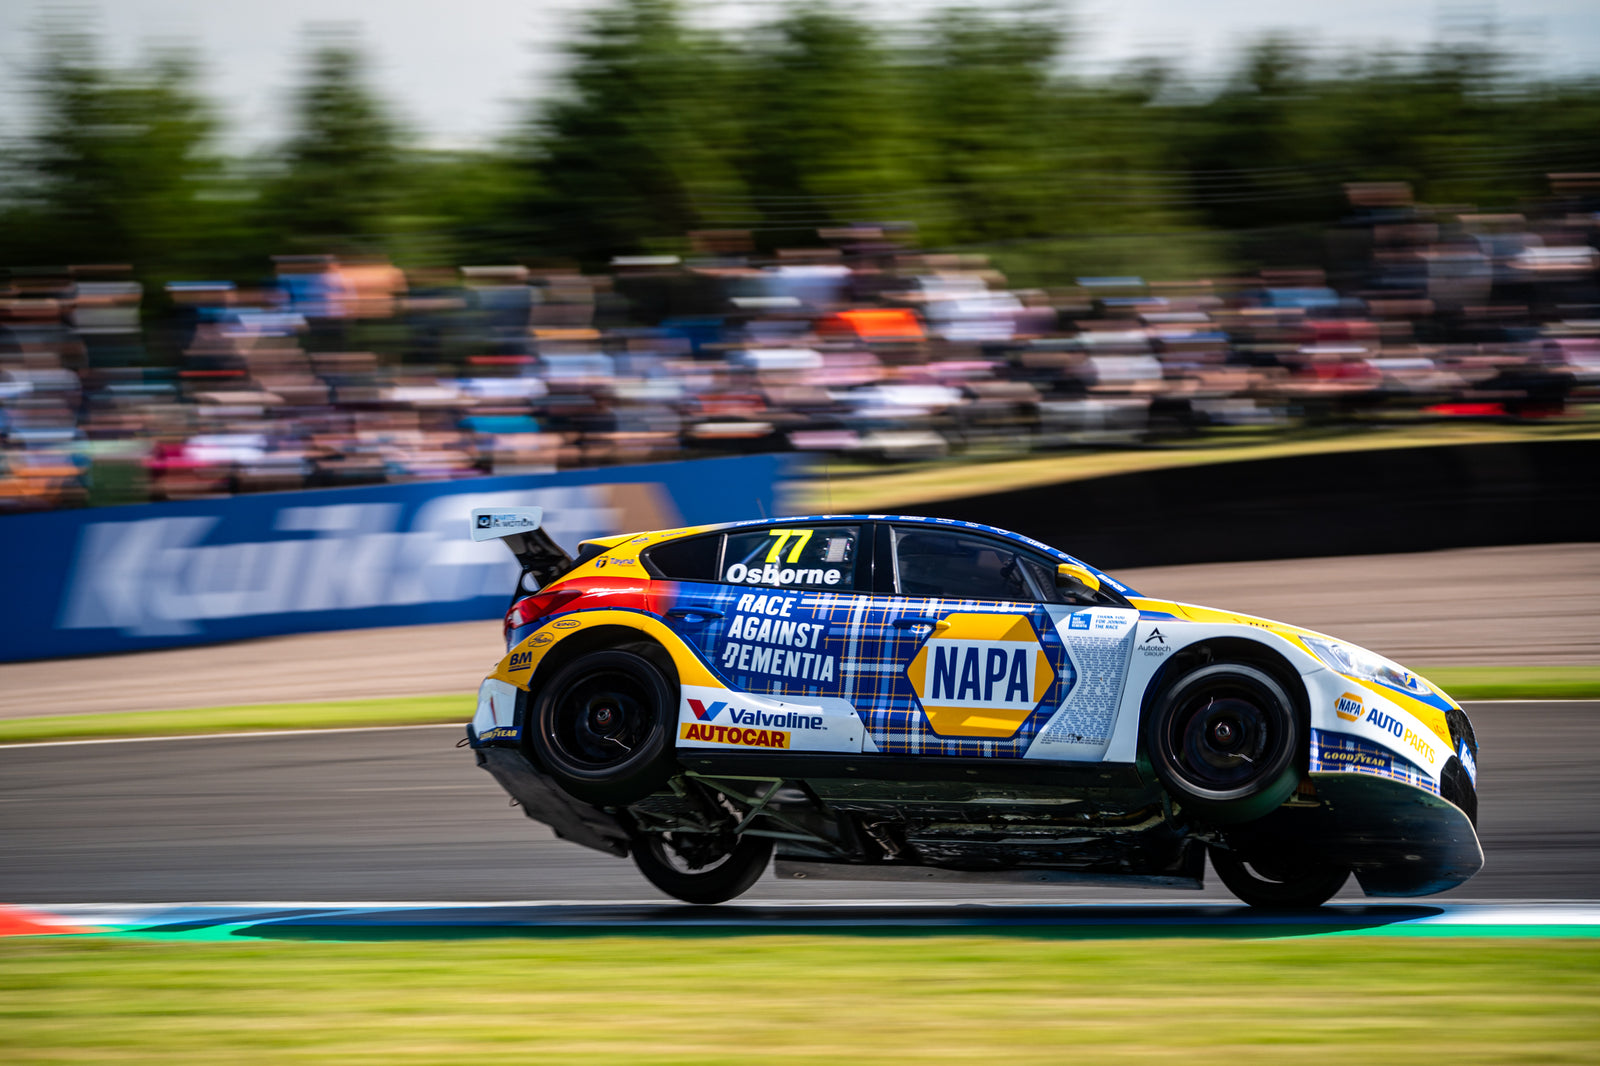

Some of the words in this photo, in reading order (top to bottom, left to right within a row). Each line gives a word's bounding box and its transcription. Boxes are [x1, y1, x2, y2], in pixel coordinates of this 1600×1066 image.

[765, 529, 814, 563] 77
[726, 563, 841, 585] Osborne
[736, 593, 797, 618] RACE
[727, 614, 825, 650] AGAINST
[509, 651, 532, 665] BM
[1137, 644, 1172, 653] Autotech
[721, 642, 834, 683] DEMENTIA
[931, 646, 1029, 703] NAPA
[729, 707, 824, 730] Valvoline
[1338, 698, 1361, 716] NAPA
[685, 723, 786, 748] AUTOCAR
[1365, 708, 1404, 738] AUTO
[1403, 728, 1436, 764] PARTS
[1323, 751, 1386, 767] GOODYEAR
